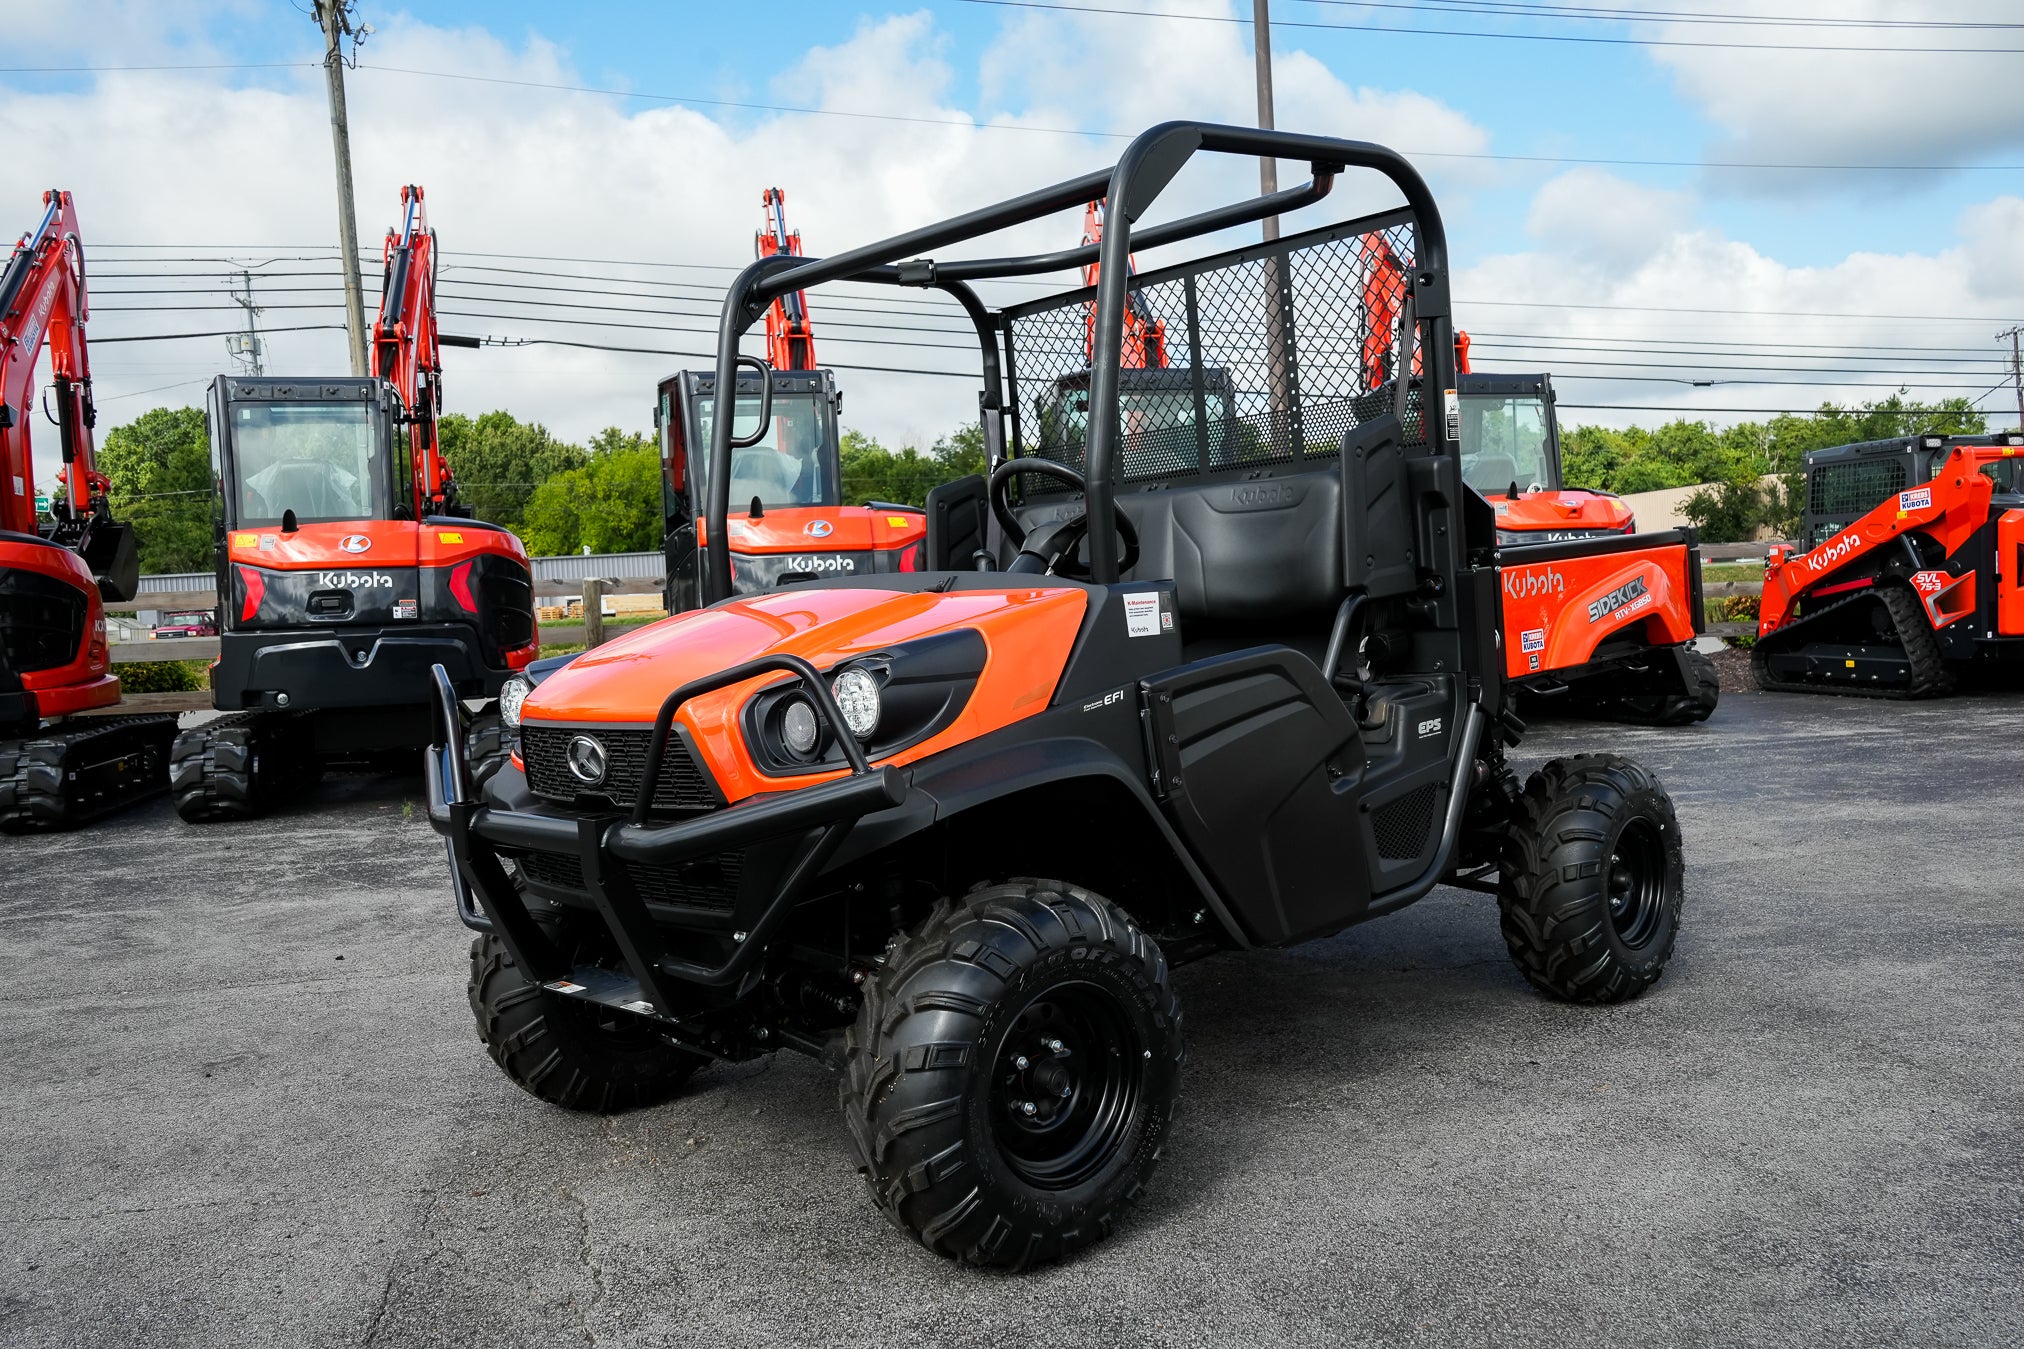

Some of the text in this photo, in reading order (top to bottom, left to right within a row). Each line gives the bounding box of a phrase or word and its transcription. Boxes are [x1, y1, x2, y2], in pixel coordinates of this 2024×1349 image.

[38, 280, 55, 318] Kubota
[1231, 483, 1294, 505] Kubota
[1902, 499, 1930, 510] KUBOTA
[1548, 532, 1596, 541] Kbt
[1808, 534, 1861, 570] Kubota
[788, 555, 854, 572] Kubota
[319, 571, 393, 589] Kubota
[1503, 566, 1564, 599] Kubota
[1916, 573, 1941, 583] SVL
[1920, 582, 1942, 591] 75-3
[1588, 576, 1648, 624] SIDEKICK
[1614, 594, 1652, 620] RTV-XG850
[1523, 640, 1544, 651] KUBOTA
[1104, 690, 1124, 705] EFI
[1418, 717, 1442, 735] EPS
